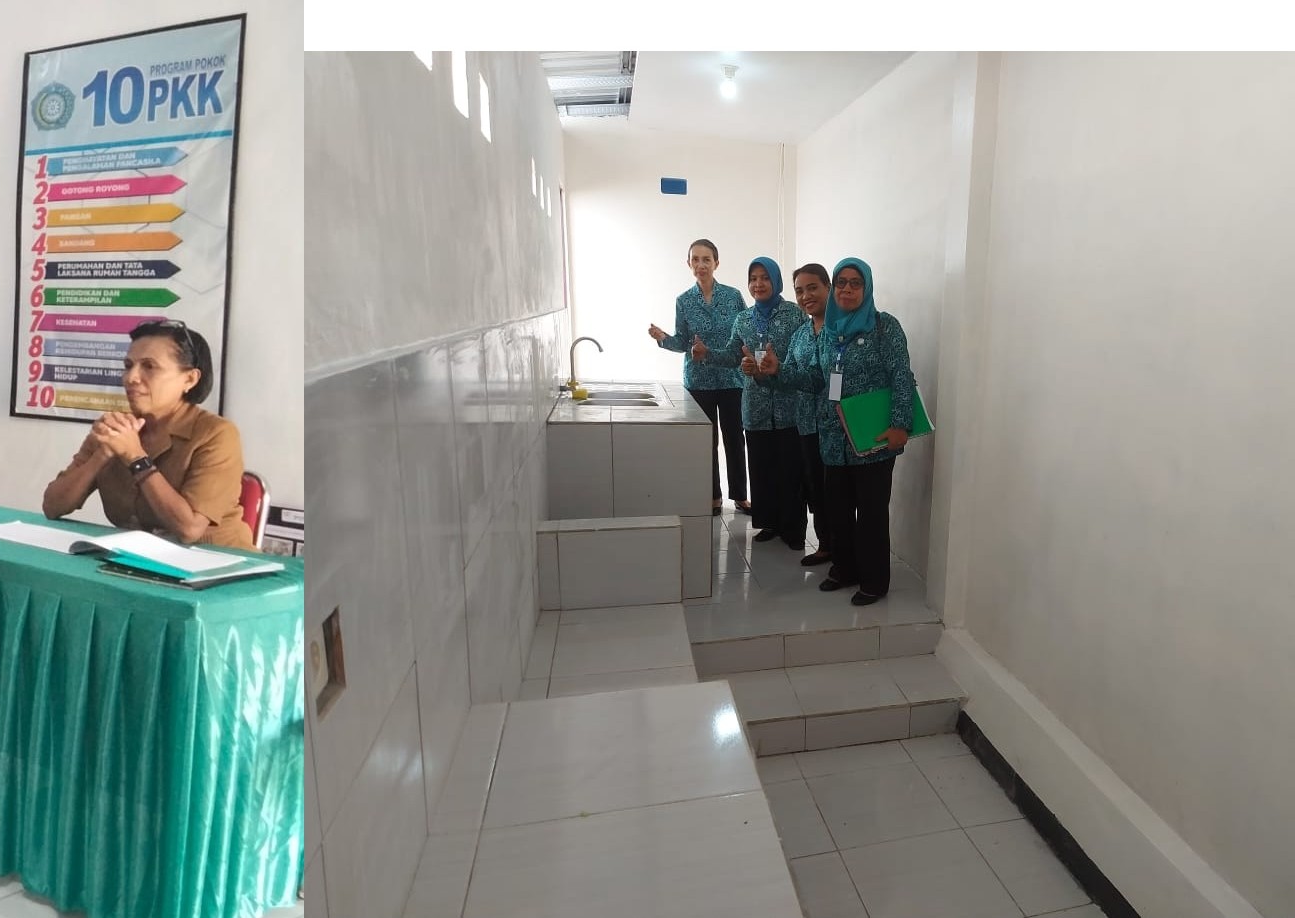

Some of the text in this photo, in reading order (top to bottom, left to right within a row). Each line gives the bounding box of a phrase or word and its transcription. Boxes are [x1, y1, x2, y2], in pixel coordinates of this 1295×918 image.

[150, 55, 227, 76] PROGRAM POKOK
[82, 66, 224, 127] 10 PKK
[116, 158, 161, 167] PANCASILA
[118, 151, 136, 160] DAN
[34, 155, 48, 179] 1
[33, 181, 49, 204] 2
[61, 184, 130, 195] GOTONG ROYONG
[32, 207, 47, 230] 3
[31, 233, 46, 256] 4
[31, 258, 46, 281] 5
[57, 262, 104, 270] PERUMAHAN
[93, 269, 121, 277] RUMAH
[30, 285, 44, 307] 6
[56, 296, 113, 304] KETERAMPILAN
[29, 310, 44, 332] 7
[55, 319, 97, 327] KESEHATAN
[28, 335, 43, 358] 8
[28, 360, 42, 382] 9
[54, 366, 103, 376] KELESTARIAN
[26, 385, 55, 408] 10
